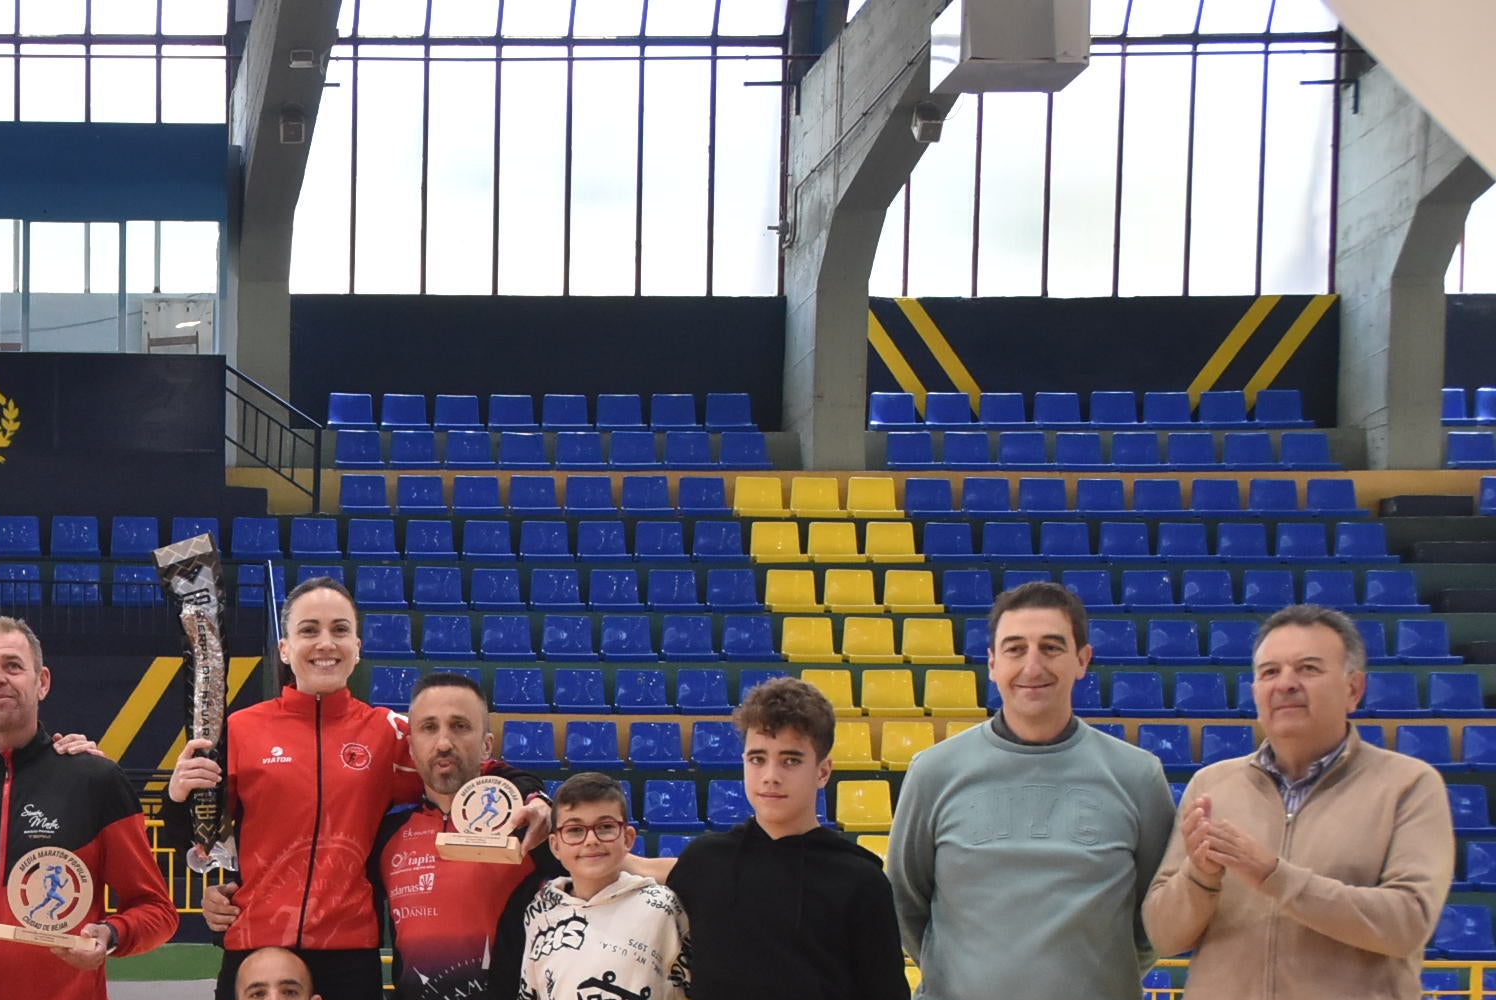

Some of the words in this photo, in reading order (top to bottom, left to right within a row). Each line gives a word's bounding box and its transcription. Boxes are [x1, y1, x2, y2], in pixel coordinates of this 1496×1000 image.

[202, 665, 211, 685] DE
[262, 756, 292, 764] VIATOR
[628, 938, 648, 951] 1975
